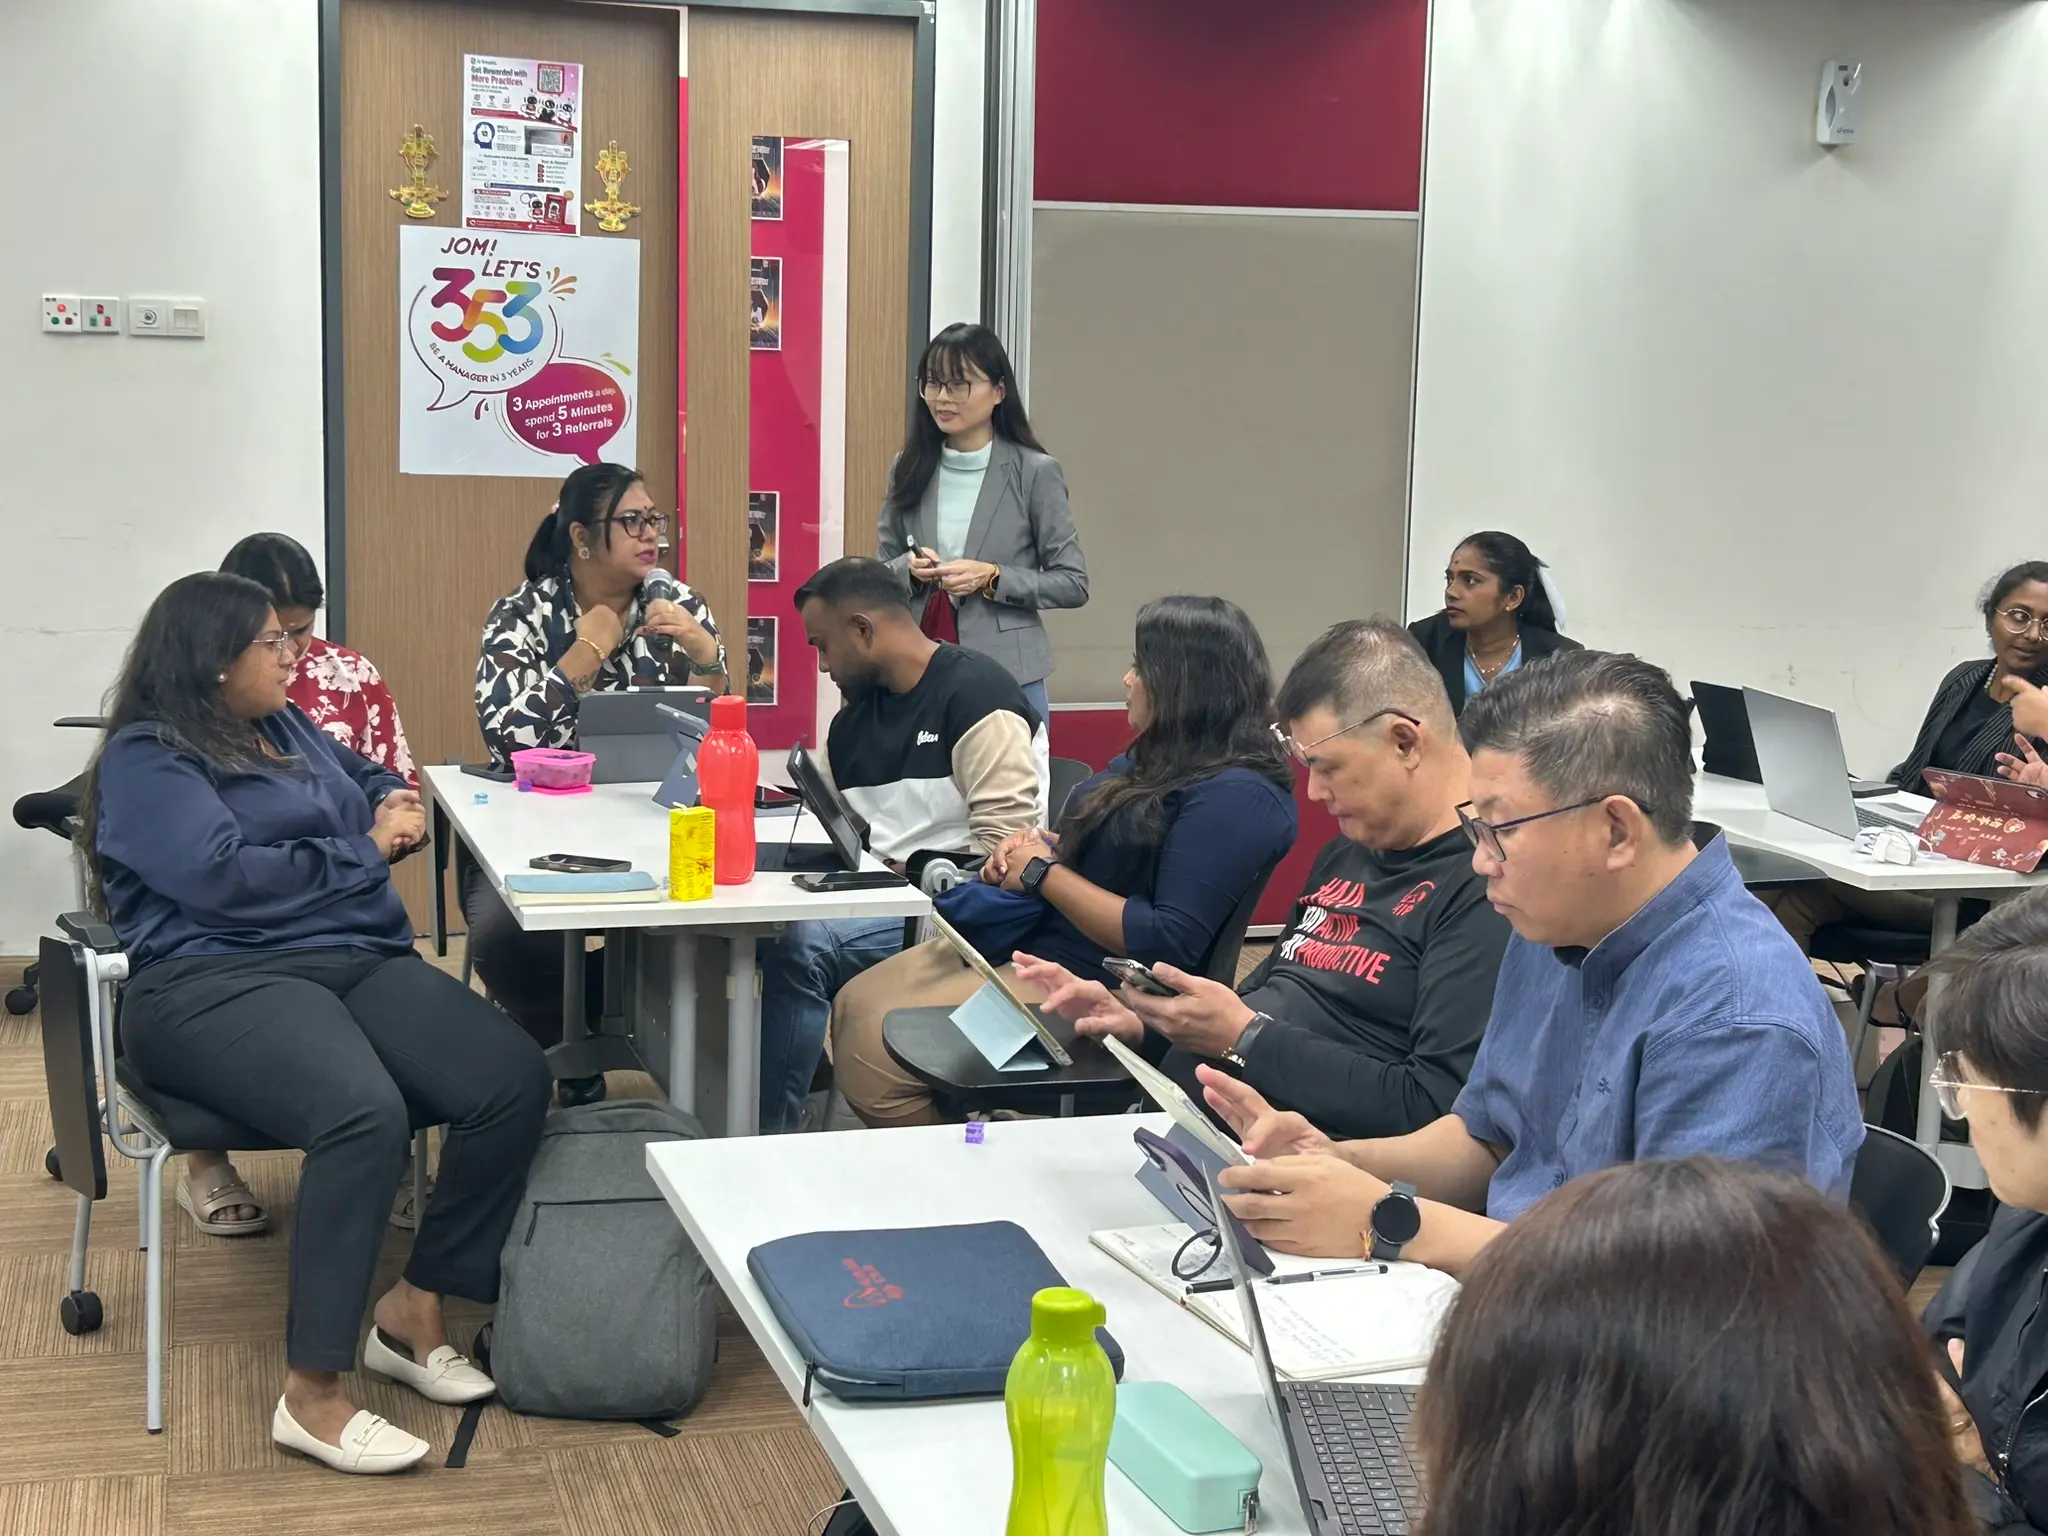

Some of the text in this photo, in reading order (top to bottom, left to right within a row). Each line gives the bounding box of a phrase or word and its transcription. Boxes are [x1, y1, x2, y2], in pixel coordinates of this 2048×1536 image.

[471, 74, 524, 87] More Practices
[483, 67, 513, 76] Rewarded
[514, 70, 528, 78] with
[441, 237, 498, 257] JOM!
[481, 259, 542, 279] LET'S
[431, 267, 544, 363] 353
[429, 342, 535, 383] BE A MANAGER IN 3 YEARS
[512, 397, 523, 412] 3
[525, 389, 594, 410] Appointments
[525, 402, 614, 428] spend 5 Minutes
[536, 417, 613, 440] for 3 Referrals
[1295, 937, 1391, 985] PRODUCTIVE
